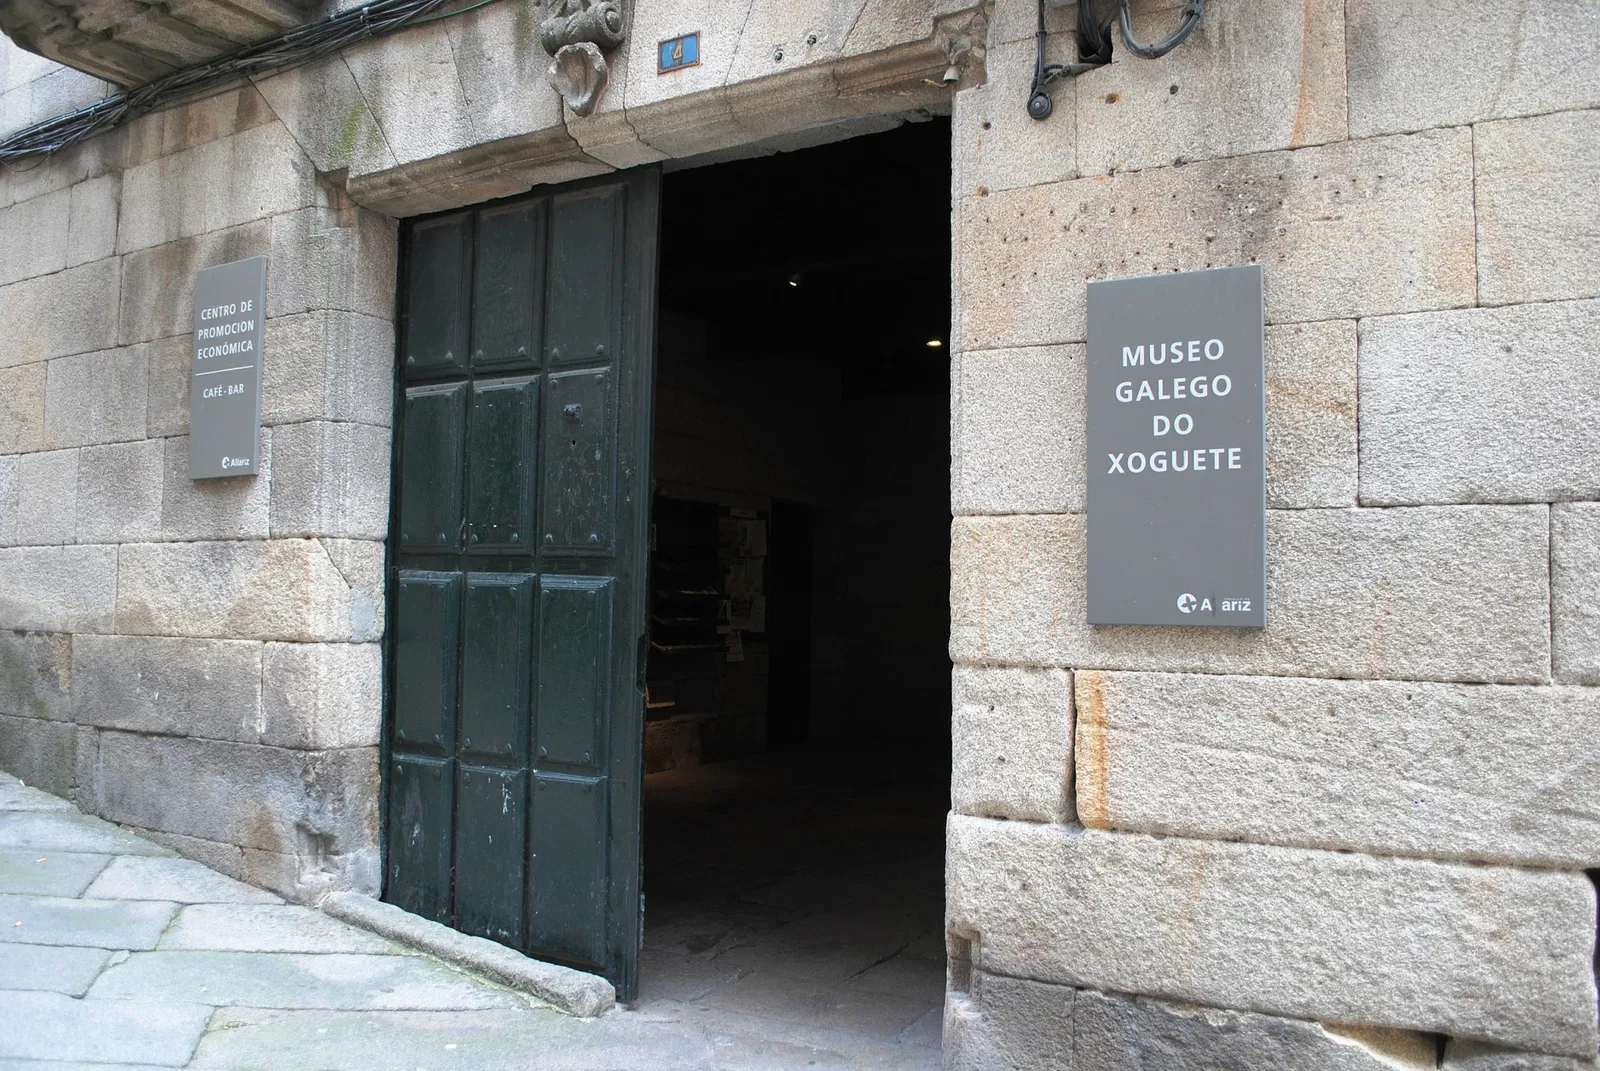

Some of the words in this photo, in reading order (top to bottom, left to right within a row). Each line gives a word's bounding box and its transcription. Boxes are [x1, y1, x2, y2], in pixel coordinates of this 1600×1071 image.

[672, 39, 683, 65] 4
[201, 303, 237, 320] CENTRO
[240, 299, 253, 313] DE
[198, 320, 254, 340] PROMOCION
[197, 340, 253, 360] ECONÓMICA
[1122, 338, 1224, 367] MUSEO
[1115, 375, 1232, 403] GALEGO
[1153, 414, 1194, 437] DO
[1107, 448, 1242, 474] XOGUETE
